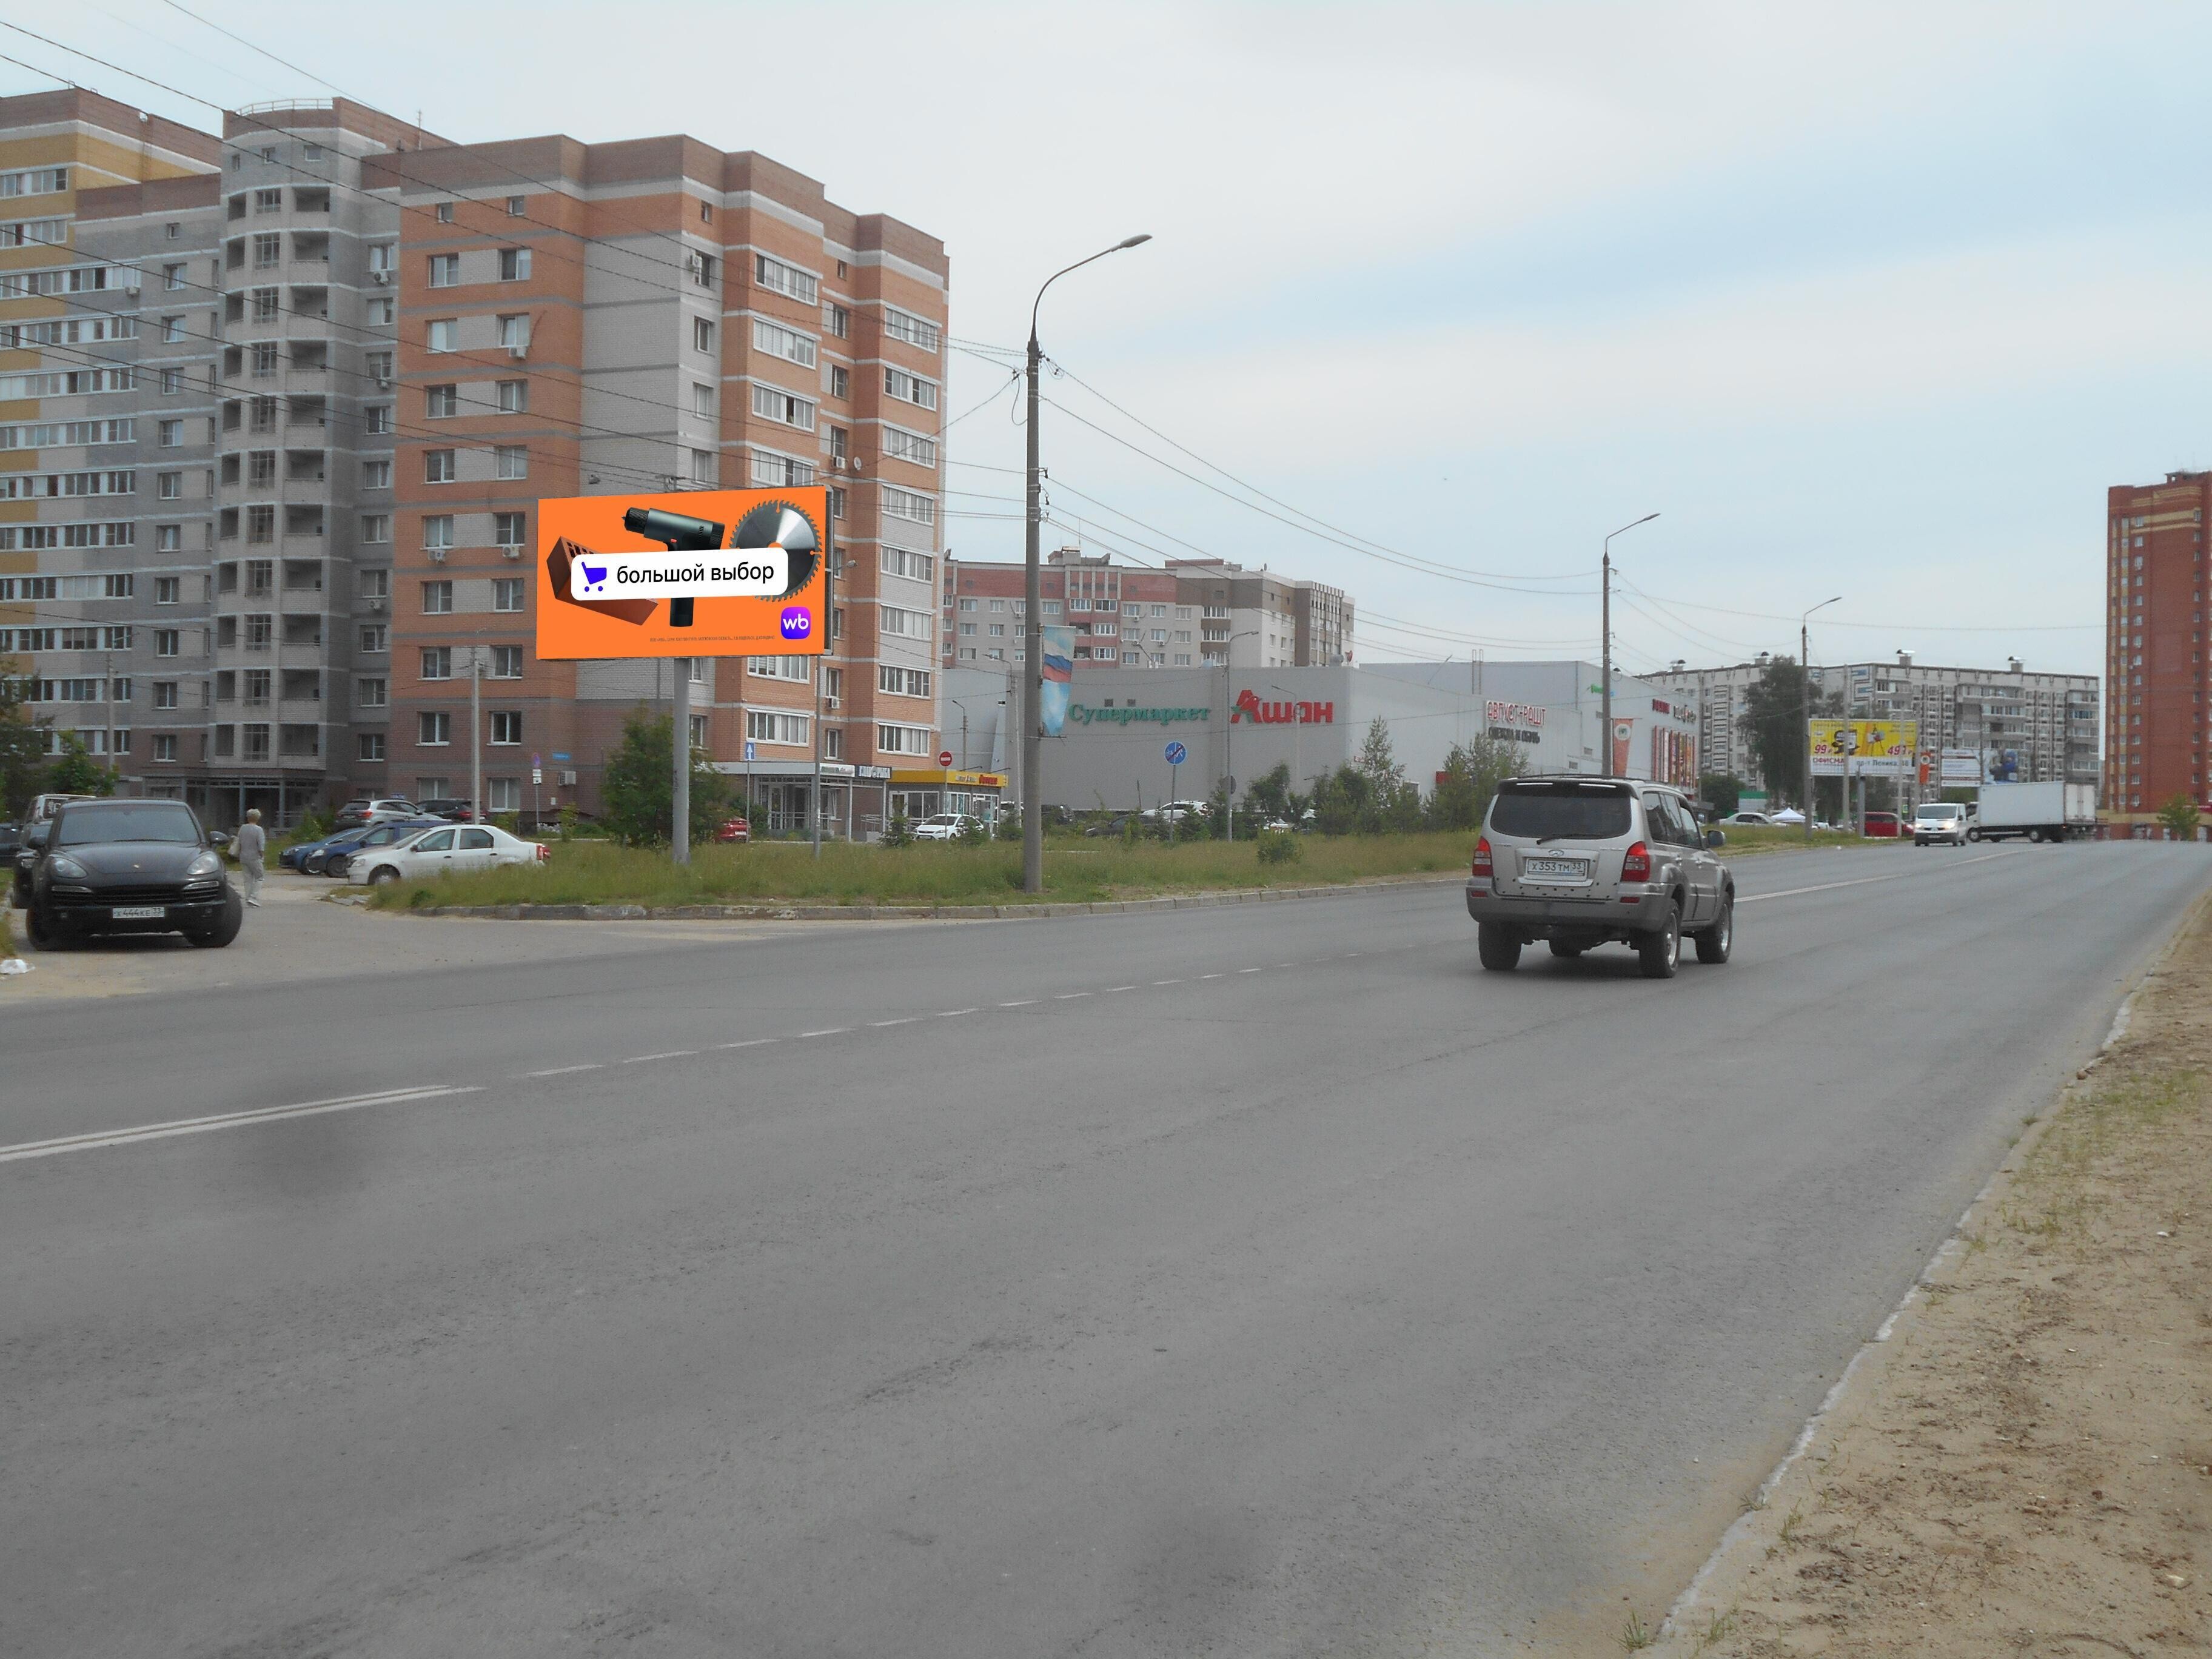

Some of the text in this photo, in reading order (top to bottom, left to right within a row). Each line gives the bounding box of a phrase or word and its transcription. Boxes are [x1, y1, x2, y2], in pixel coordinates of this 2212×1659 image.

[617, 561, 774, 584] большой выбор
[782, 613, 809, 630] wb
[1068, 704, 1211, 726] Супермаркет
[1814, 744, 1826, 754] 99
